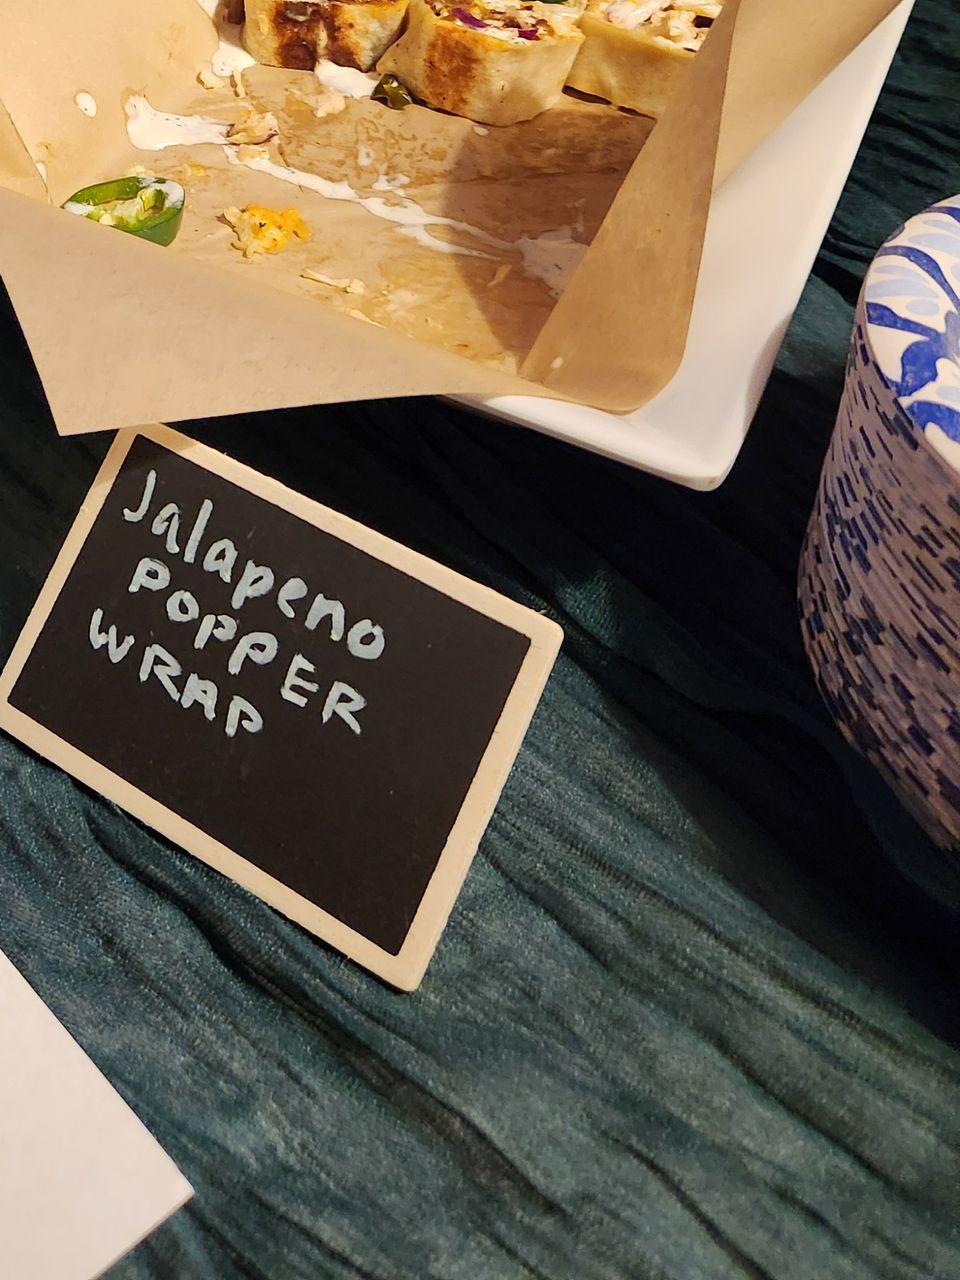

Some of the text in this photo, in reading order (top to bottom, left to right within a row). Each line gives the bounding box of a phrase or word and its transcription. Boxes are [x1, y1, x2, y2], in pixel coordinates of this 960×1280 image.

[122, 469, 385, 660] Jalapeno
[128, 556, 367, 735] POPPER
[88, 608, 264, 738] WRAP
